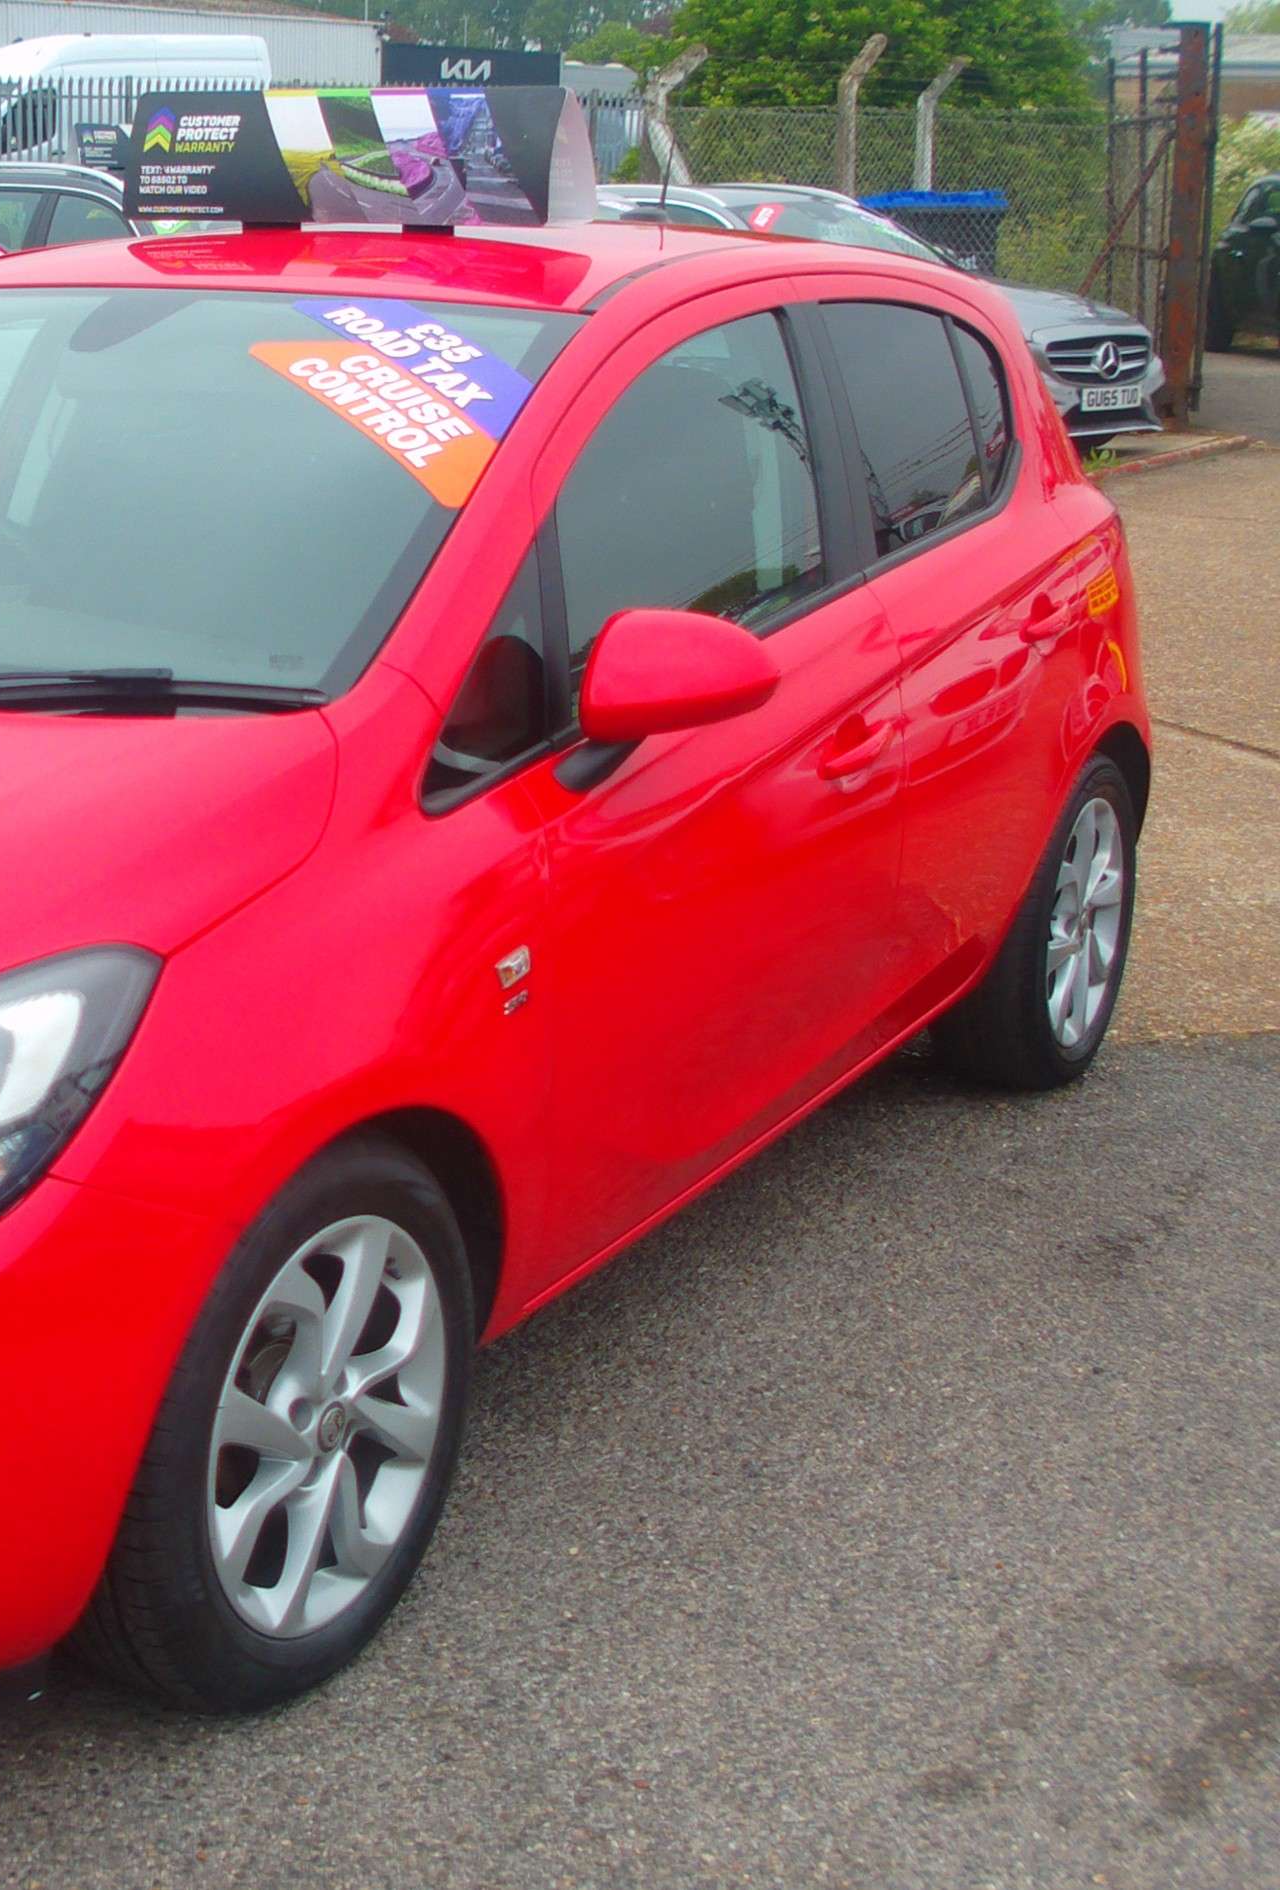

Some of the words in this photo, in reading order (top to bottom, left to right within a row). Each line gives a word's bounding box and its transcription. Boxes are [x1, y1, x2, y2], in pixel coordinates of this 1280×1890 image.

[440, 57, 492, 81] KIA
[179, 115, 241, 127] CUSTOMER
[176, 127, 239, 141] PROTECT
[175, 141, 235, 153] WARRANTY
[140, 175, 151, 184] TO
[177, 175, 188, 184] TO
[139, 185, 166, 195] WATCH
[166, 185, 183, 194] OUR
[183, 185, 208, 194] VIDEO
[403, 322, 484, 364] £35
[323, 305, 421, 359] ROAD
[410, 356, 494, 409] TAX
[339, 354, 474, 442] CRUISE
[288, 357, 443, 469] CONTROL
